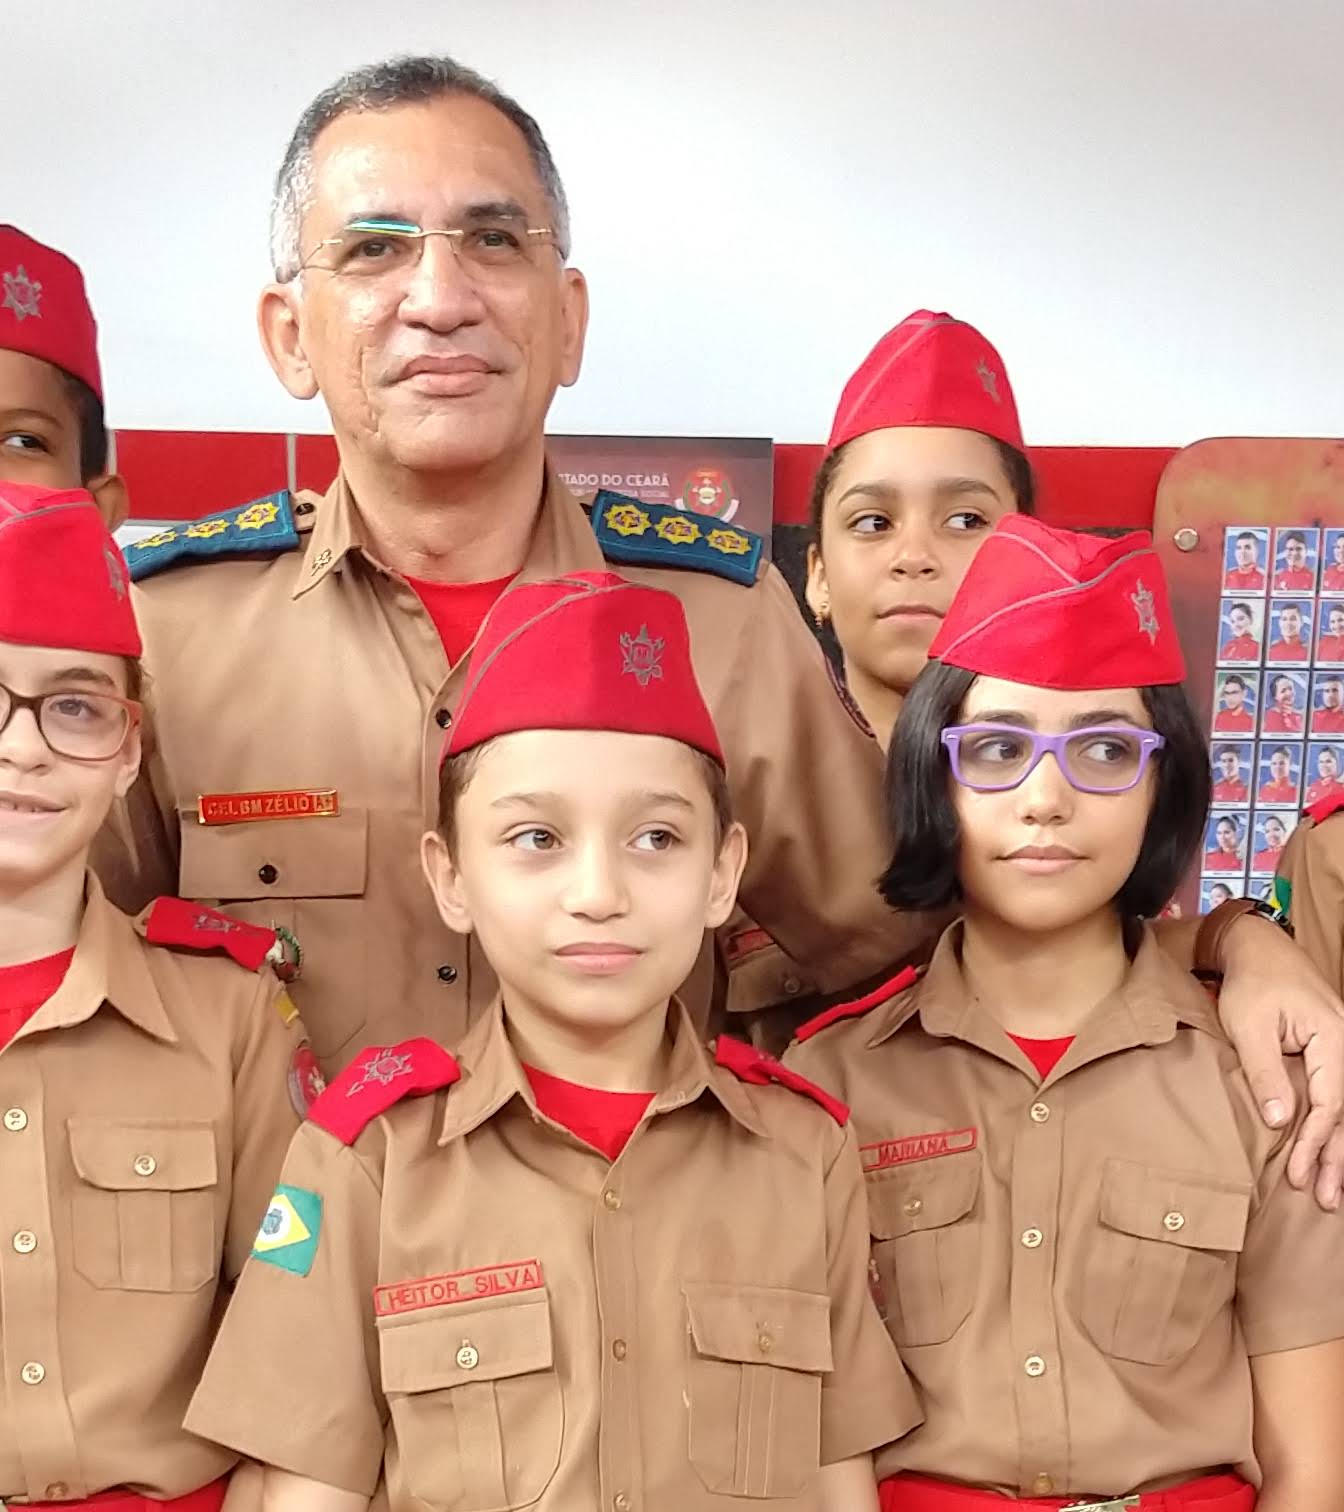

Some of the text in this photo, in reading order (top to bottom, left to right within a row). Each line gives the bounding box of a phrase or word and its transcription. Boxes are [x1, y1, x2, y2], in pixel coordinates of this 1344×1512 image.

[602, 474, 623, 486] DO
[626, 471, 670, 487] CEARÁ
[265, 795, 310, 813] ZÉLIO
[387, 1268, 535, 1311] HEITOR SILVA
